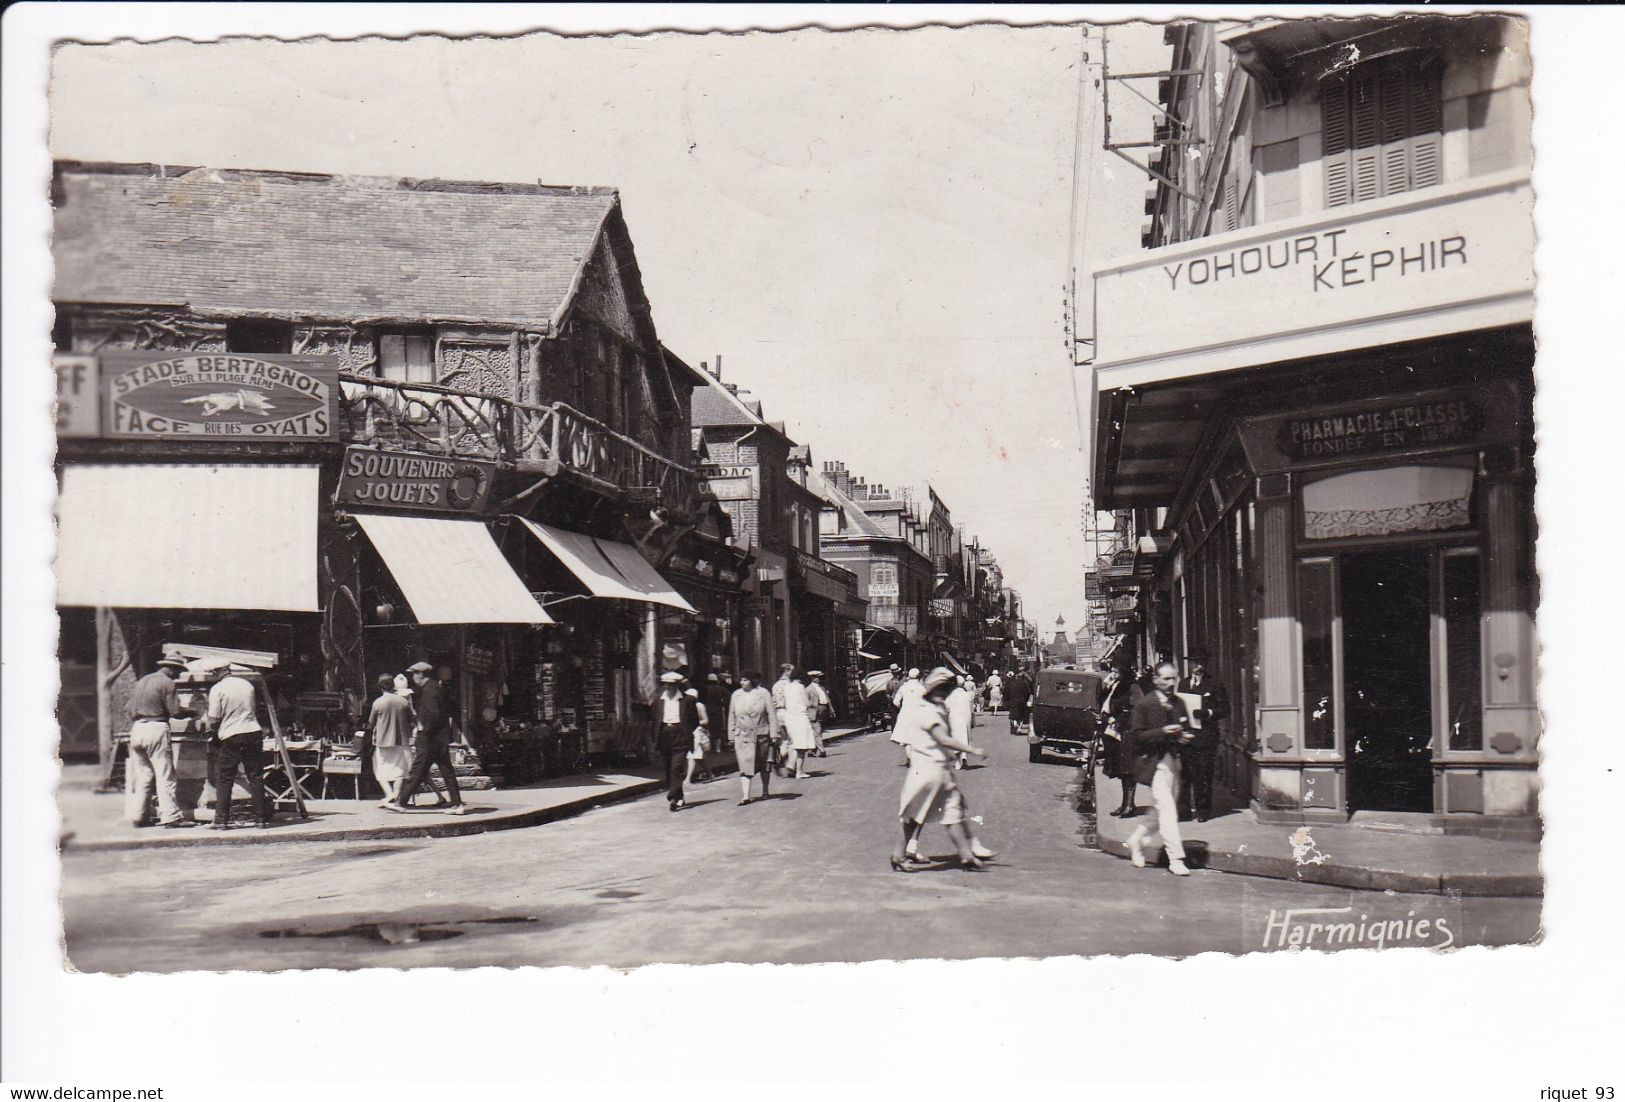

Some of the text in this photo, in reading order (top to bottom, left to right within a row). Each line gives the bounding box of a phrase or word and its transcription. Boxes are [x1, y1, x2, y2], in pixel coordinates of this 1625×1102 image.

[1164, 229, 1346, 290] YOHOURT
[1313, 235, 1467, 292] KÉPHIR
[114, 357, 323, 399] STADE BERTAGNOL
[171, 374, 194, 386] SUR
[199, 373, 211, 382] LA
[216, 373, 246, 383] PLAGE
[114, 401, 327, 435] FACE RUE DES OYATS
[1293, 412, 1382, 444] PHARMACIE
[1383, 432, 1405, 447] EN
[348, 452, 455, 479] SOUVENIRS
[356, 482, 440, 504] JOUETS
